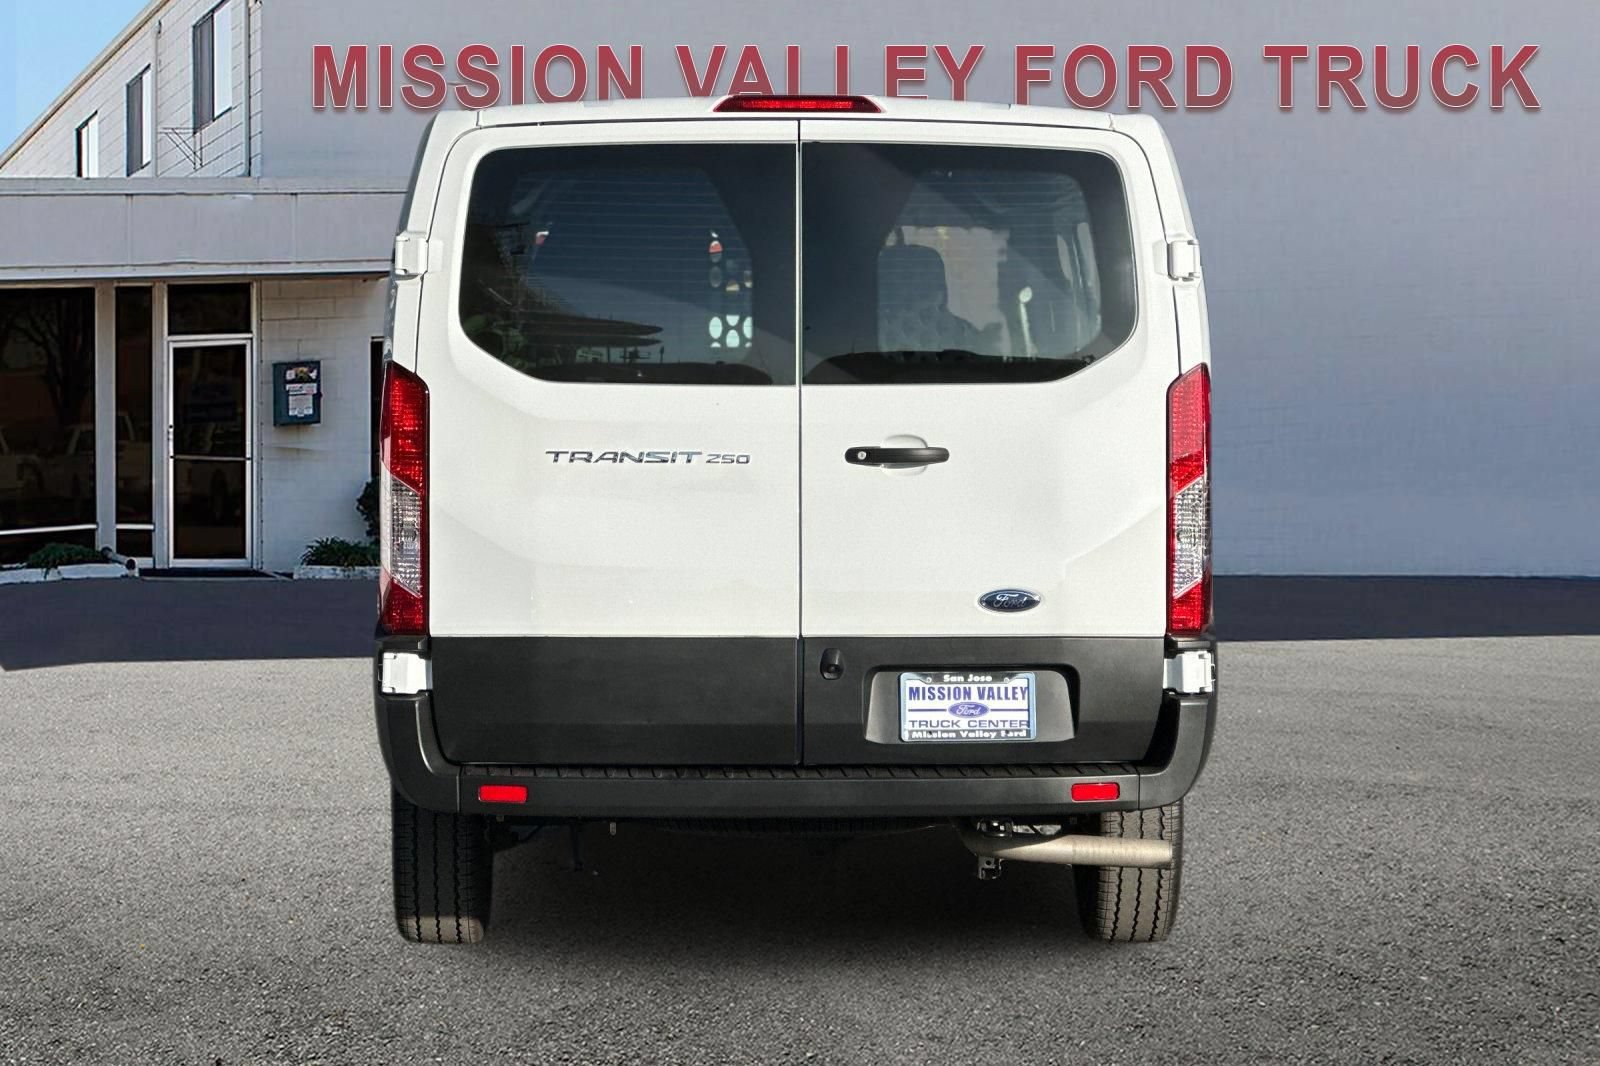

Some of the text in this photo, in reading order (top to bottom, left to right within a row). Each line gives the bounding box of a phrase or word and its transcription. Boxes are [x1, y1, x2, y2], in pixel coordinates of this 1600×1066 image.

[312, 44, 1541, 109] MISSION VALLEY FORD TRUCK
[545, 450, 751, 464] TRANSIT 250
[993, 593, 1028, 608] Ford
[943, 674, 993, 683] San Jose
[908, 686, 1028, 701] MISSION VALLEY
[956, 704, 981, 717] Ford
[909, 719, 1030, 729] TRUCK CENTER
[911, 730, 957, 739] Mission
[959, 730, 997, 739] Valley
